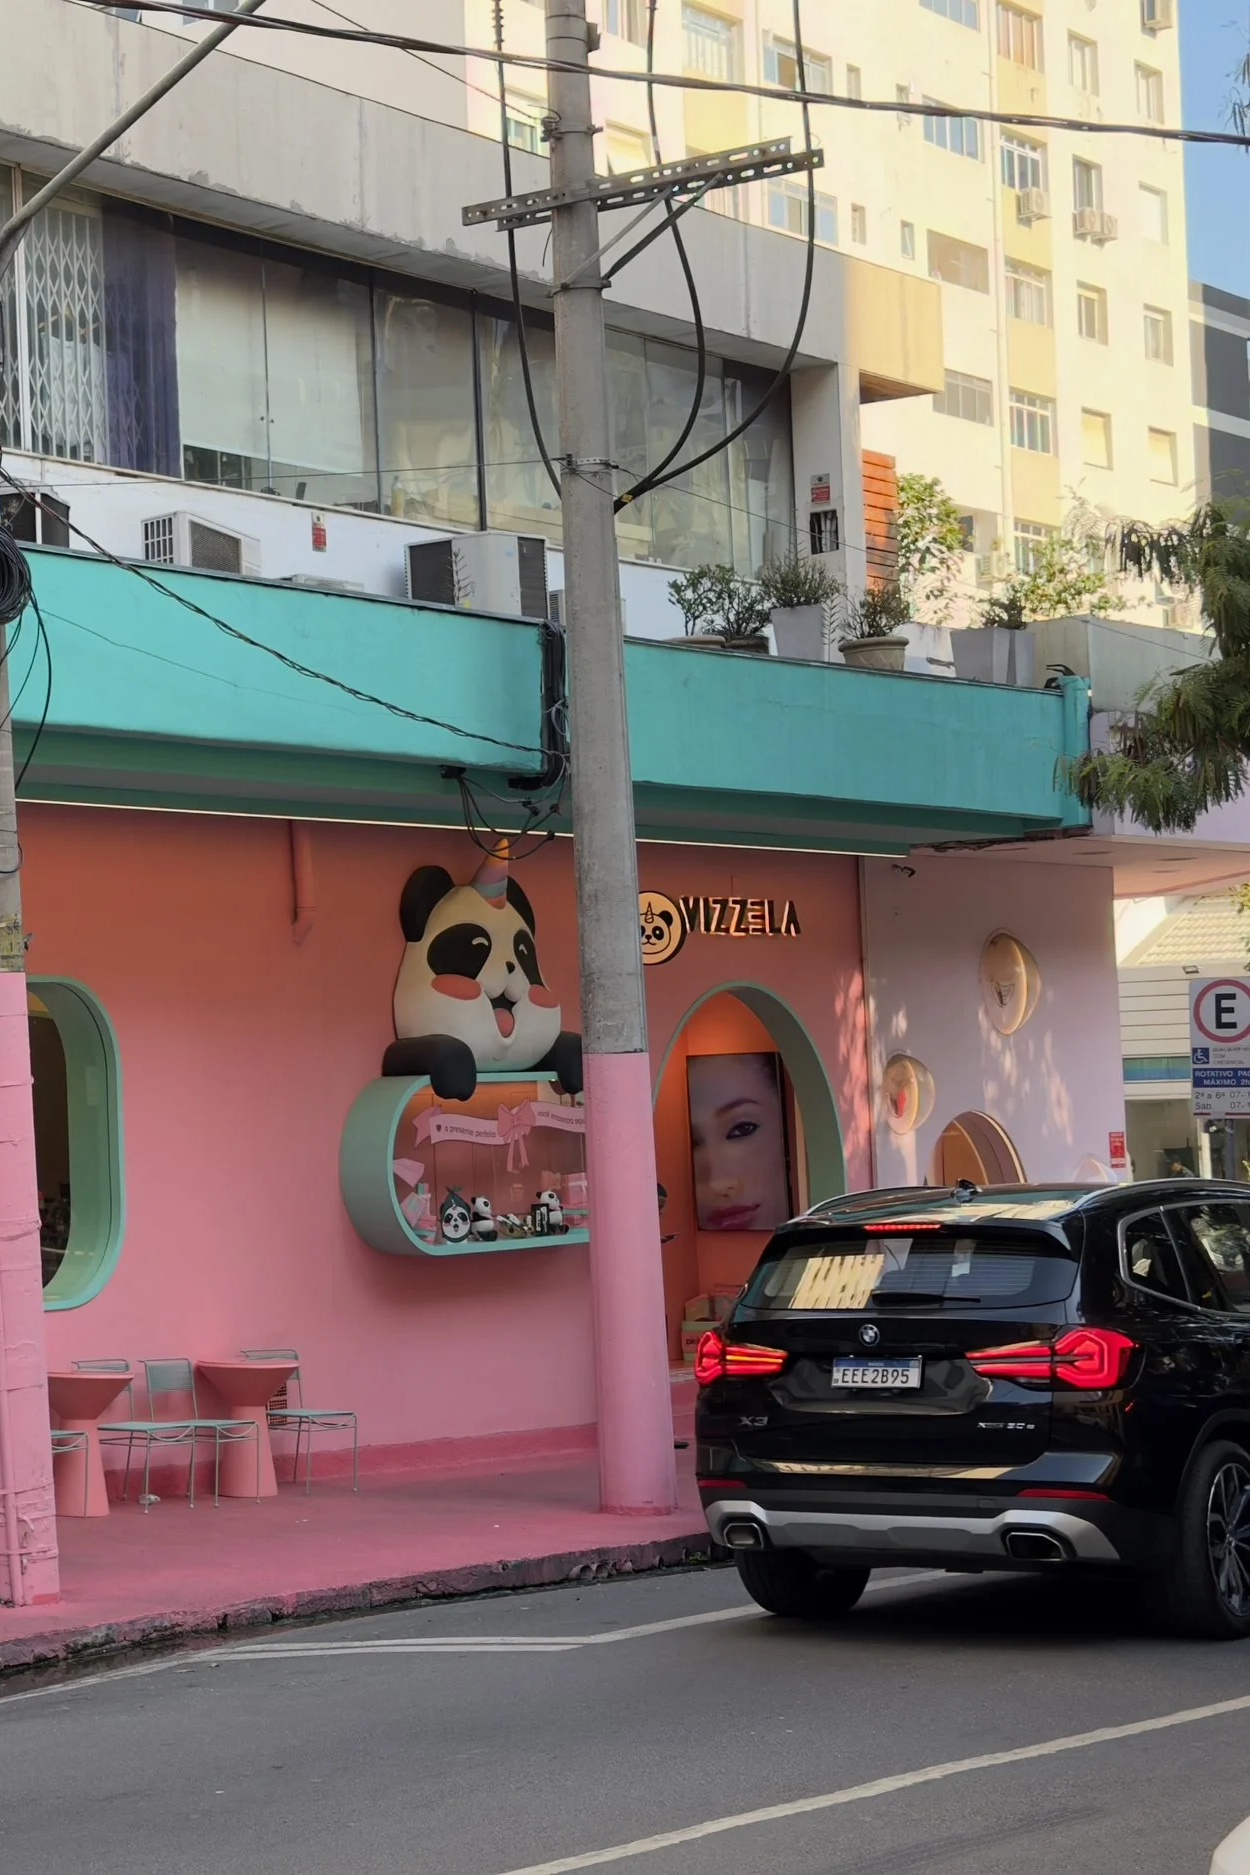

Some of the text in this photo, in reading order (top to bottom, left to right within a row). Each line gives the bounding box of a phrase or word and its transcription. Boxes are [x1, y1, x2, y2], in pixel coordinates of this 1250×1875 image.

[679, 895, 801, 937] VIZZELA
[1215, 992, 1237, 1030] E
[841, 1368, 910, 1384] EEE2B95
